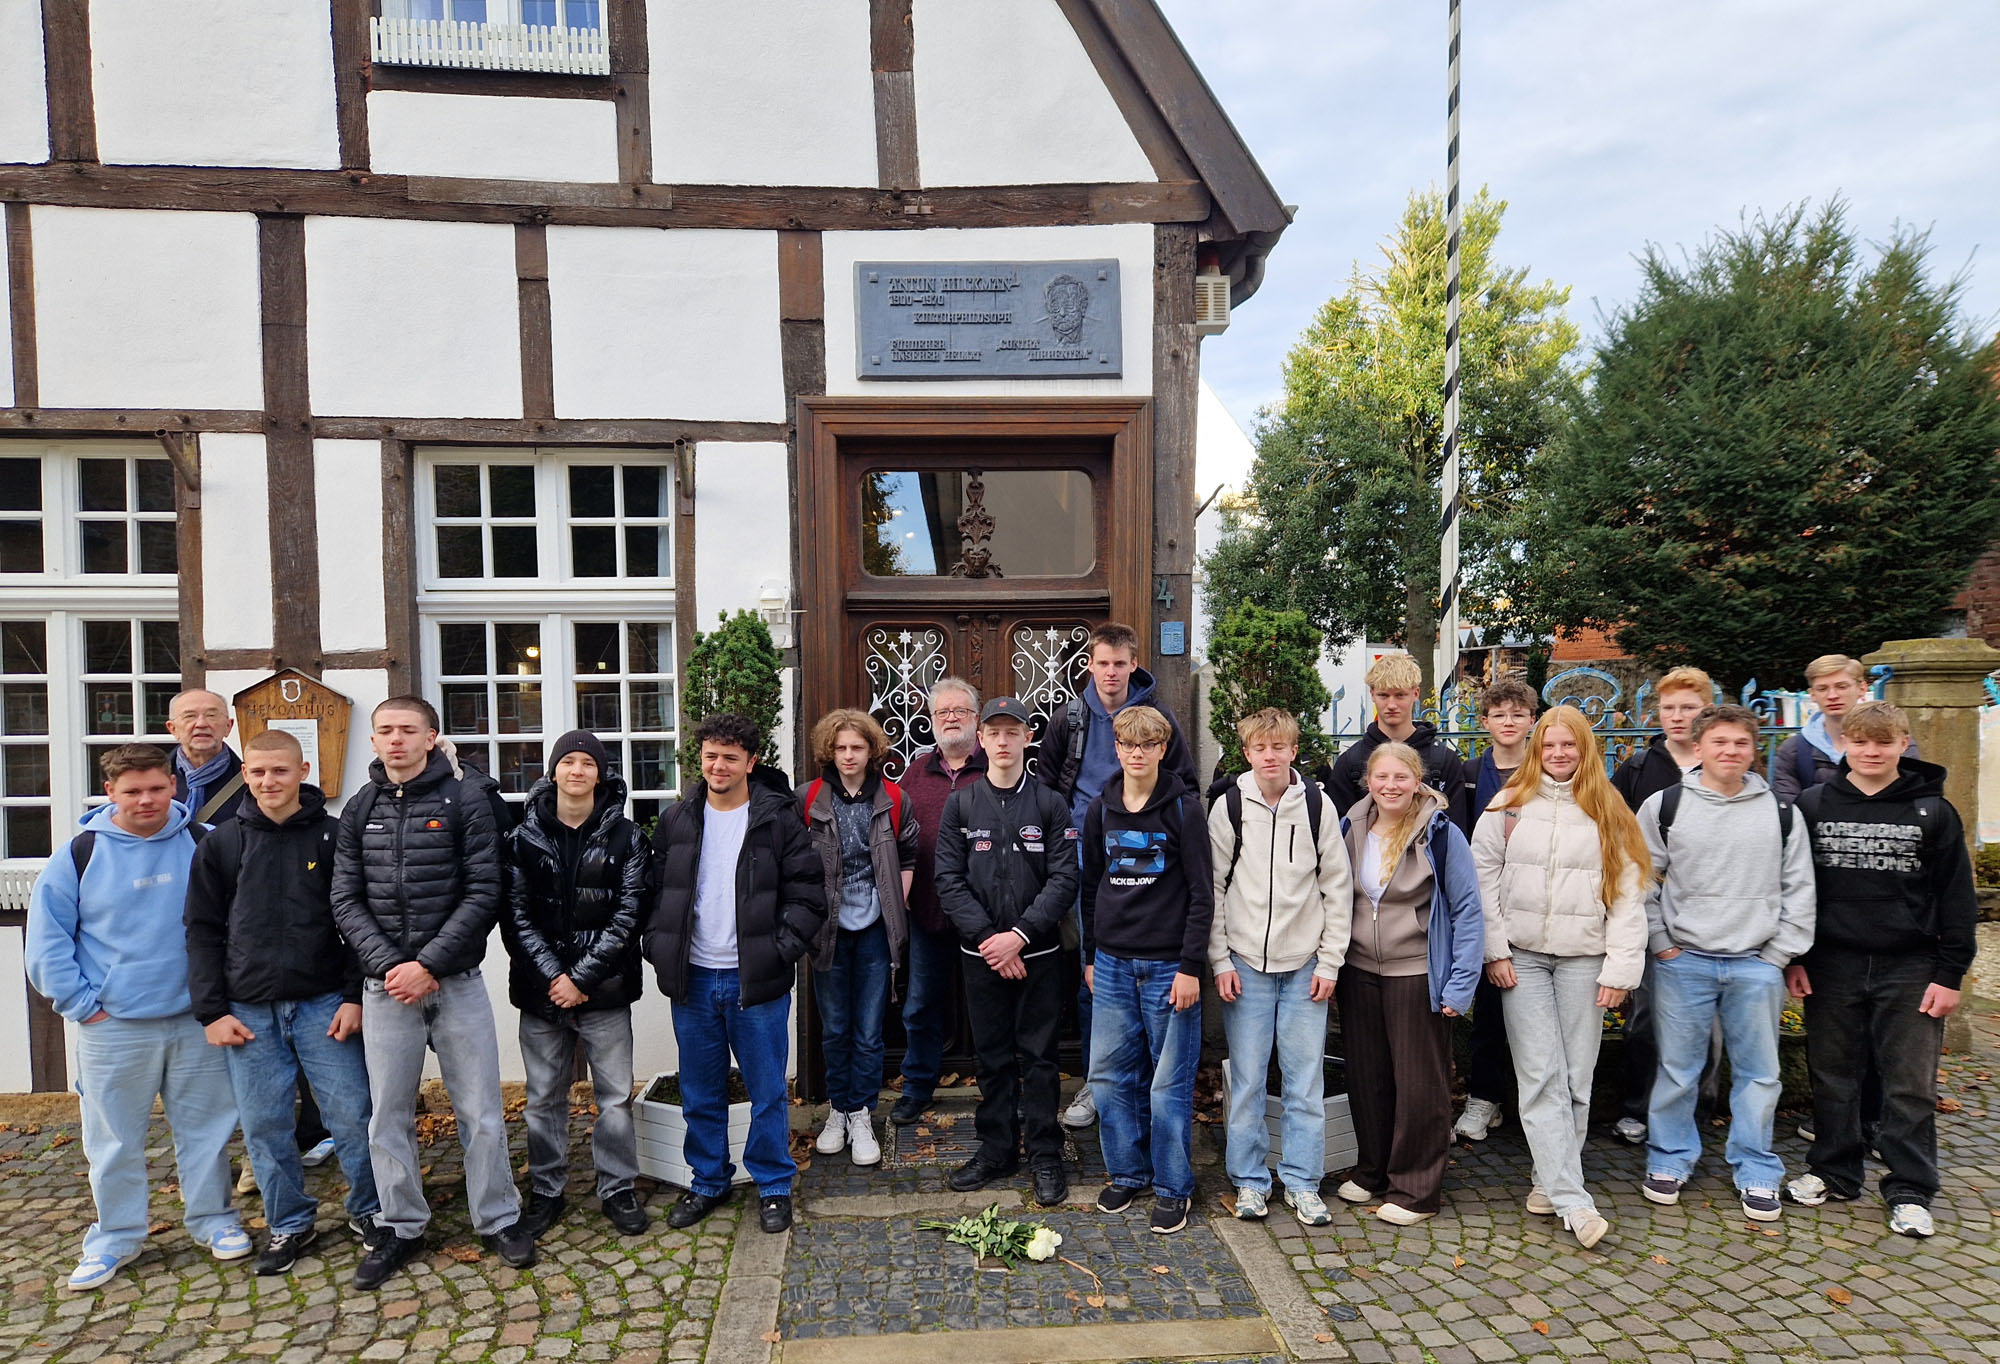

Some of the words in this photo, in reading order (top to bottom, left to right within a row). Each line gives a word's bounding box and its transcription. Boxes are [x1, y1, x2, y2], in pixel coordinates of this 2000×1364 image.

[888, 277, 937, 293] ANTON
[913, 312, 1013, 325] KULTURPHILOSOPH
[1157, 580, 1174, 608] 4
